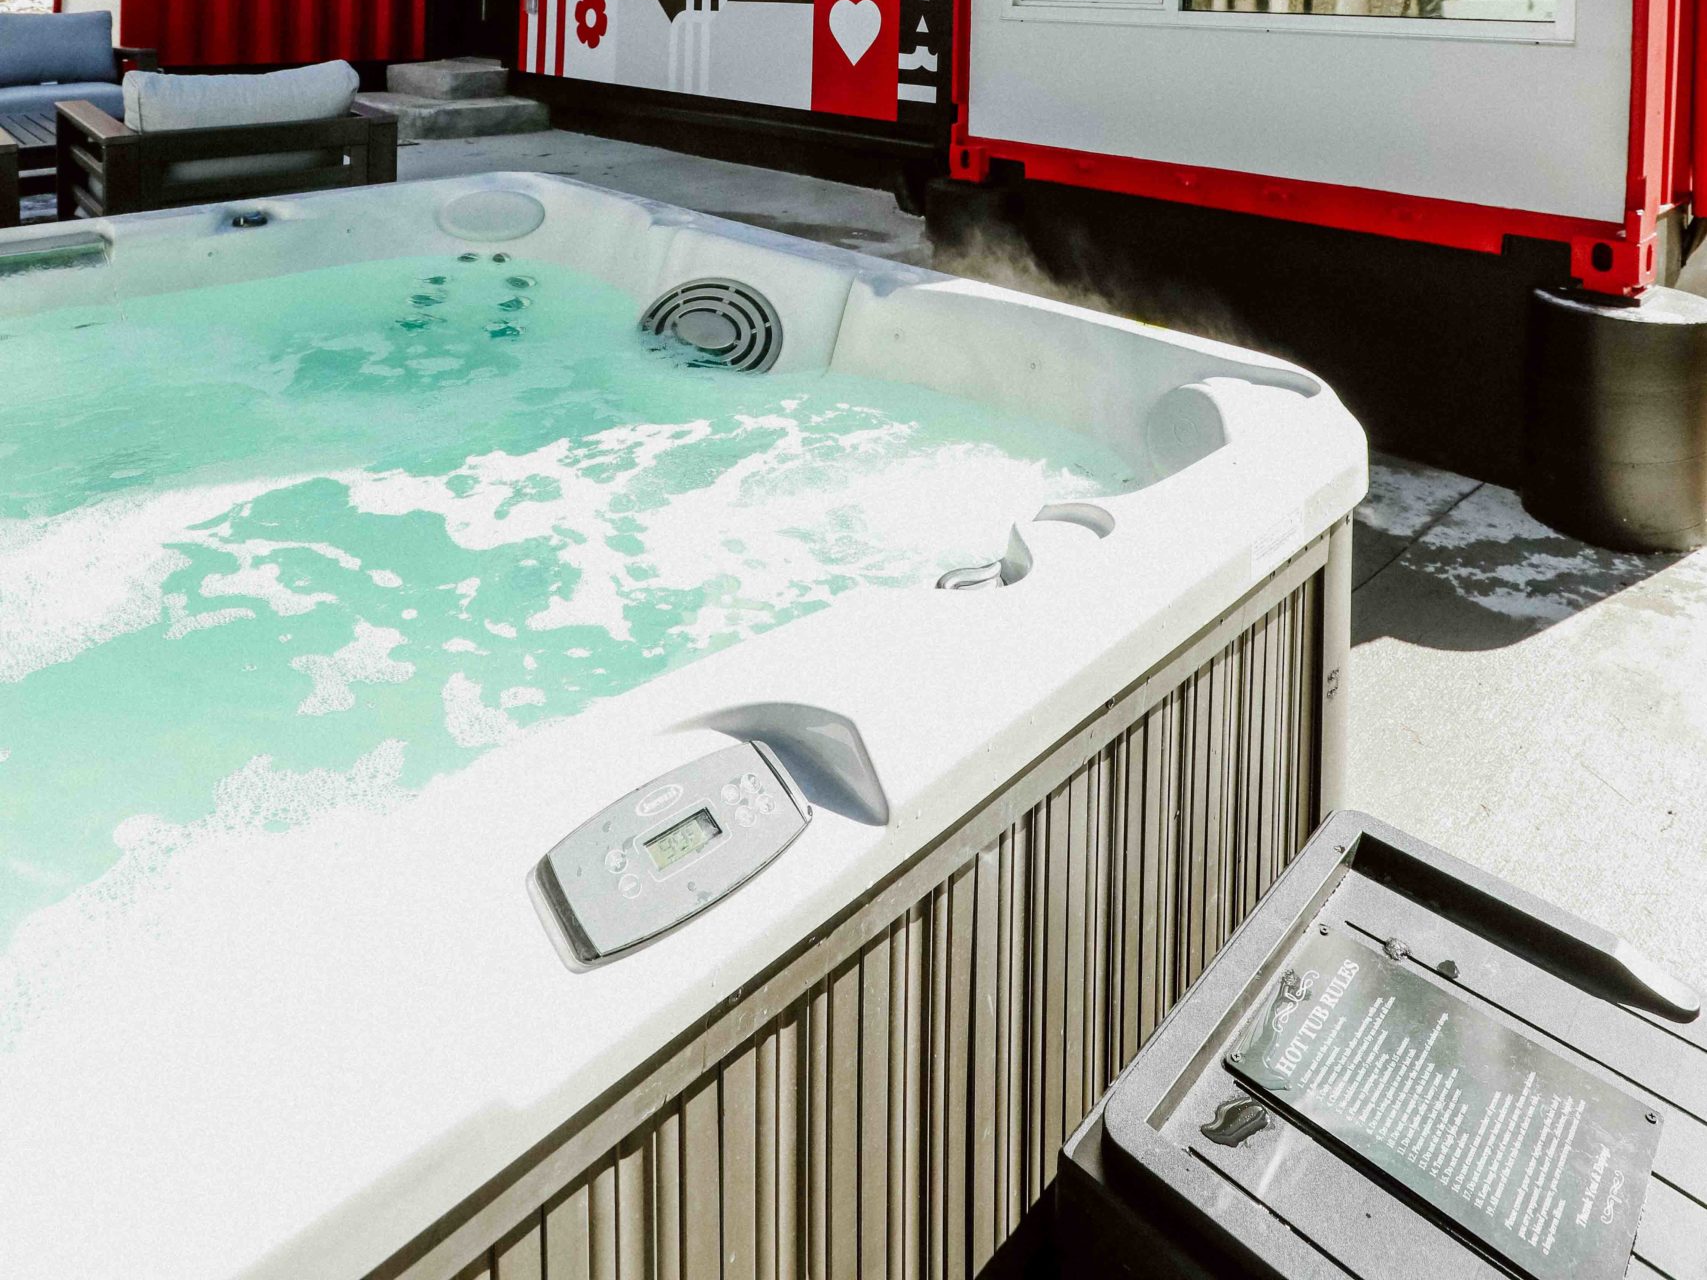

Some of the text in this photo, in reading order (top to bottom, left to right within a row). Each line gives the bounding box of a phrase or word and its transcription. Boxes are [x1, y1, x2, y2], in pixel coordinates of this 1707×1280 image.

[1273, 957, 1361, 1077] HOT TUB RULES
[1405, 1150, 1417, 1163] 12.
[1449, 1179, 1461, 1193] 16.
[1461, 1186, 1472, 1200] 17.
[1573, 1194, 1593, 1228] Thank
[1583, 1176, 1599, 1200] You
[1484, 1203, 1496, 1217] 19.
